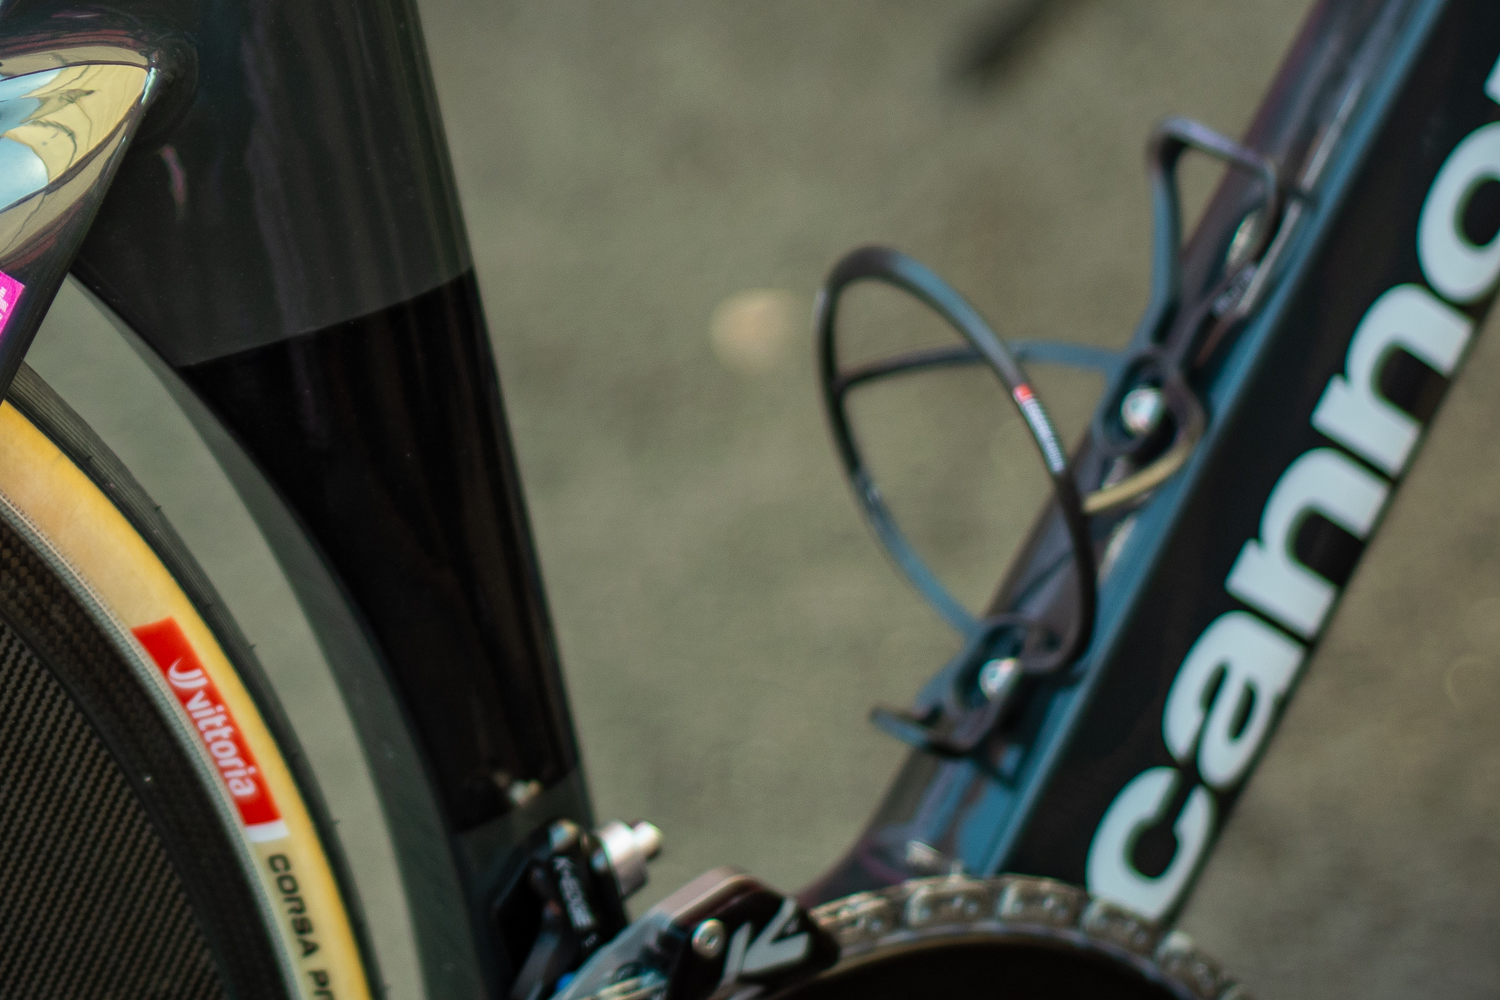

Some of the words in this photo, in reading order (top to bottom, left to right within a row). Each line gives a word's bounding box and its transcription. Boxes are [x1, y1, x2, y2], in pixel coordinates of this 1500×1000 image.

[1086, 48, 1500, 922] canno
[186, 690, 257, 797] vittoria
[267, 853, 320, 959] CORSA
